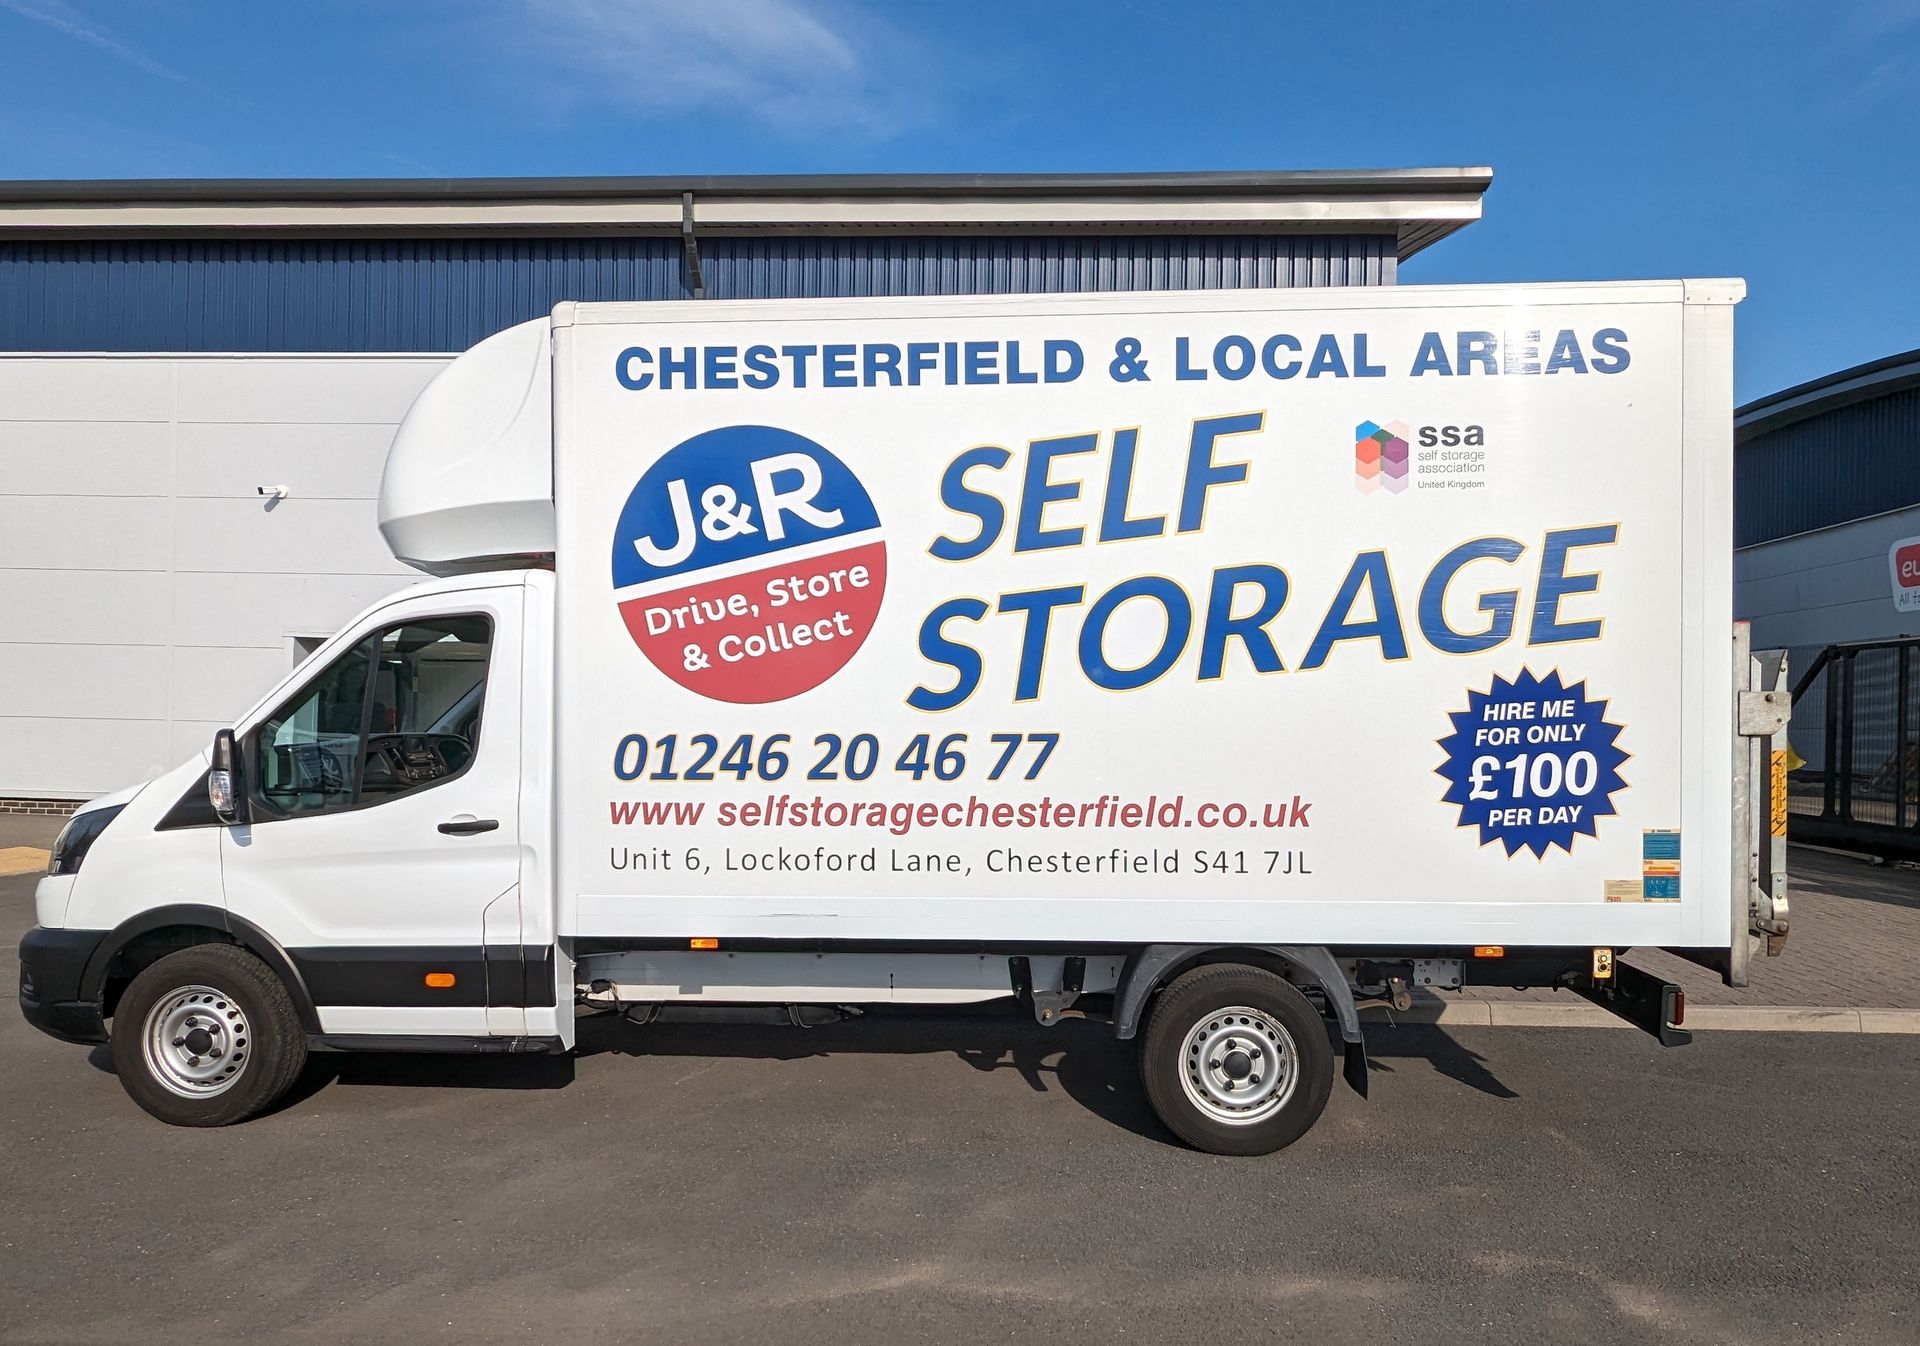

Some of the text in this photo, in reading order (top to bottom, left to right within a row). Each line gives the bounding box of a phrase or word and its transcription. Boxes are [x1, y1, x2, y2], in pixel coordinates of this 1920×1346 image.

[616, 328, 1630, 390] CHESTERFIELD & LOCAL AREAS
[1419, 425, 1484, 447] ssa
[1418, 450, 1485, 462] self storage
[1418, 463, 1485, 474] association
[925, 409, 1267, 564] SELF
[1418, 480, 1485, 490] United Kingdom
[633, 452, 845, 568] J&R
[644, 564, 870, 637] Drive, Store
[1900, 592, 1910, 606] All
[903, 521, 1622, 714] STORAGE
[684, 610, 854, 671] & Collect
[1484, 700, 1574, 721] HIRE ME
[1476, 724, 1585, 746] FOR ONLY
[612, 733, 1062, 784] 01246 20 46 77
[1469, 751, 1597, 800] £100
[611, 795, 1309, 835] www selfstoragechesterfield.co.uk
[1489, 806, 1582, 826] PER DAY
[611, 847, 1312, 876] Unit 6, Lockoford Lane, Chesterfield S41 7JL
